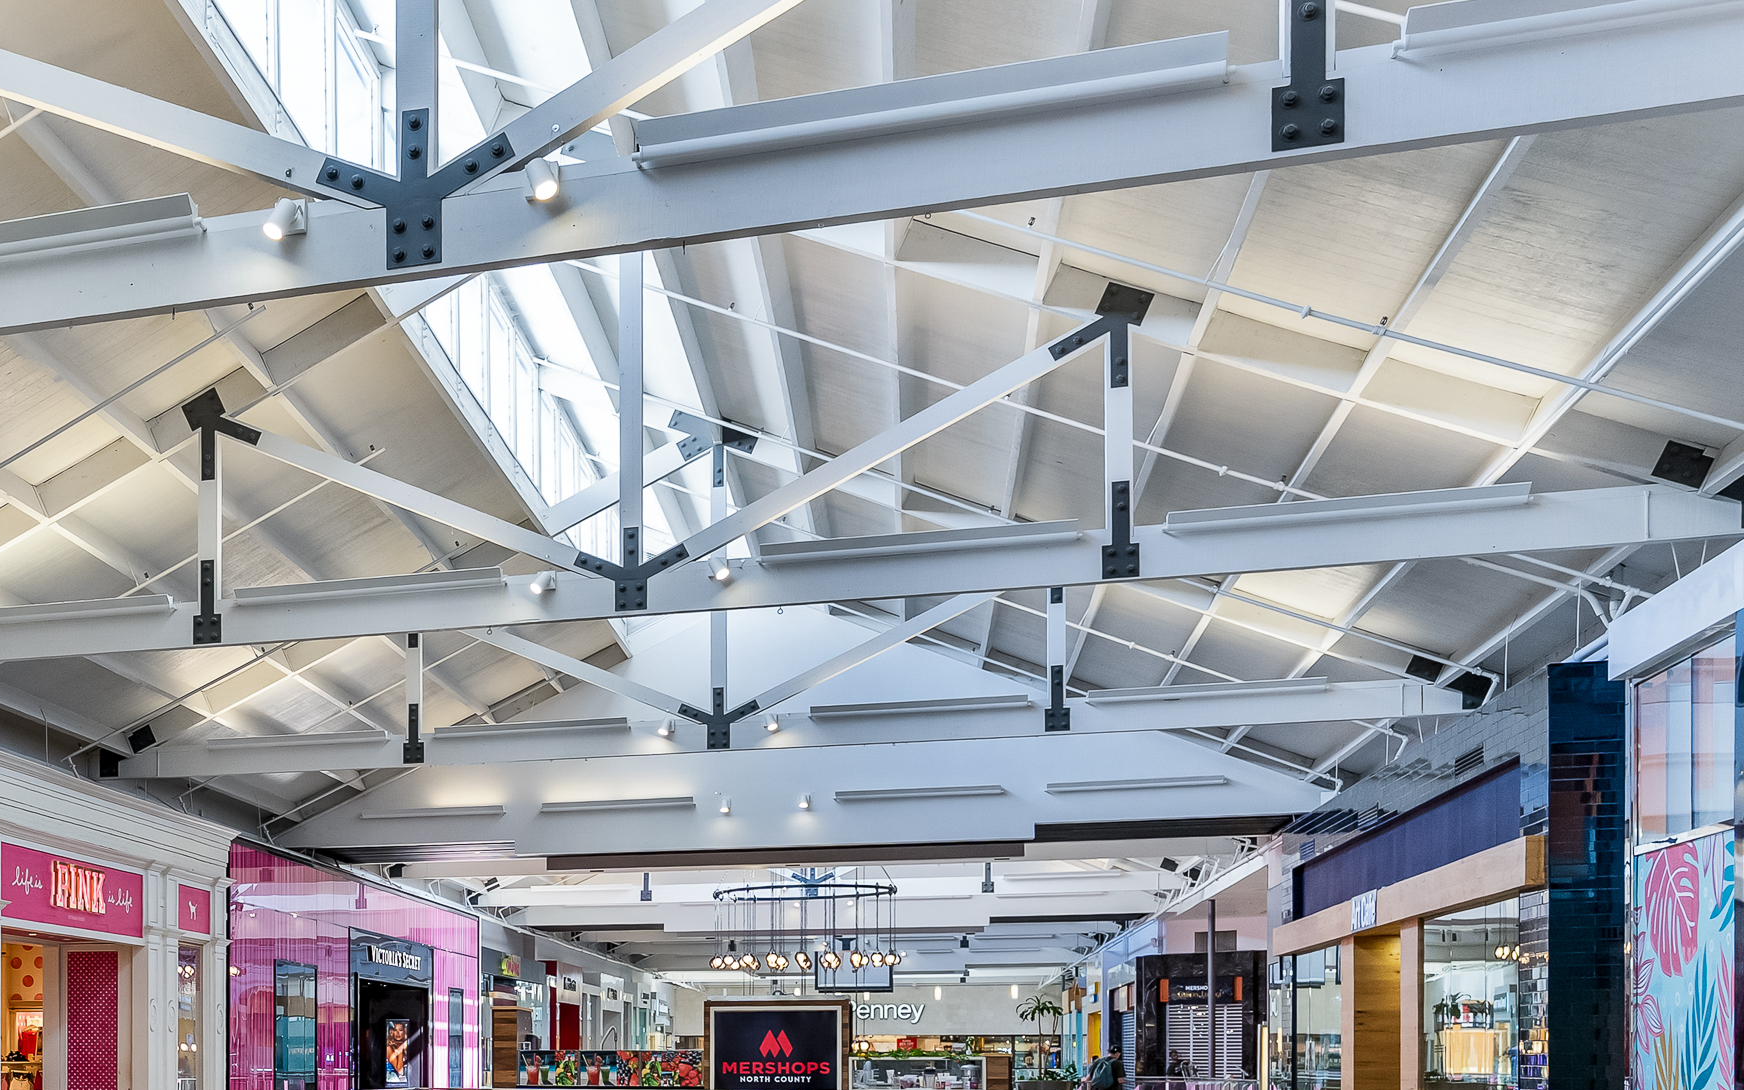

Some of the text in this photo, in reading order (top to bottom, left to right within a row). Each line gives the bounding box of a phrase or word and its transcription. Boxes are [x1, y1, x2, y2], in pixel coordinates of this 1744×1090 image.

[12, 865, 33, 895] life
[34, 875, 43, 889] is
[52, 861, 106, 915] PINK
[115, 888, 133, 913] life
[402, 952, 421, 970] SECRET
[722, 1061, 830, 1074] MERSHOPS
